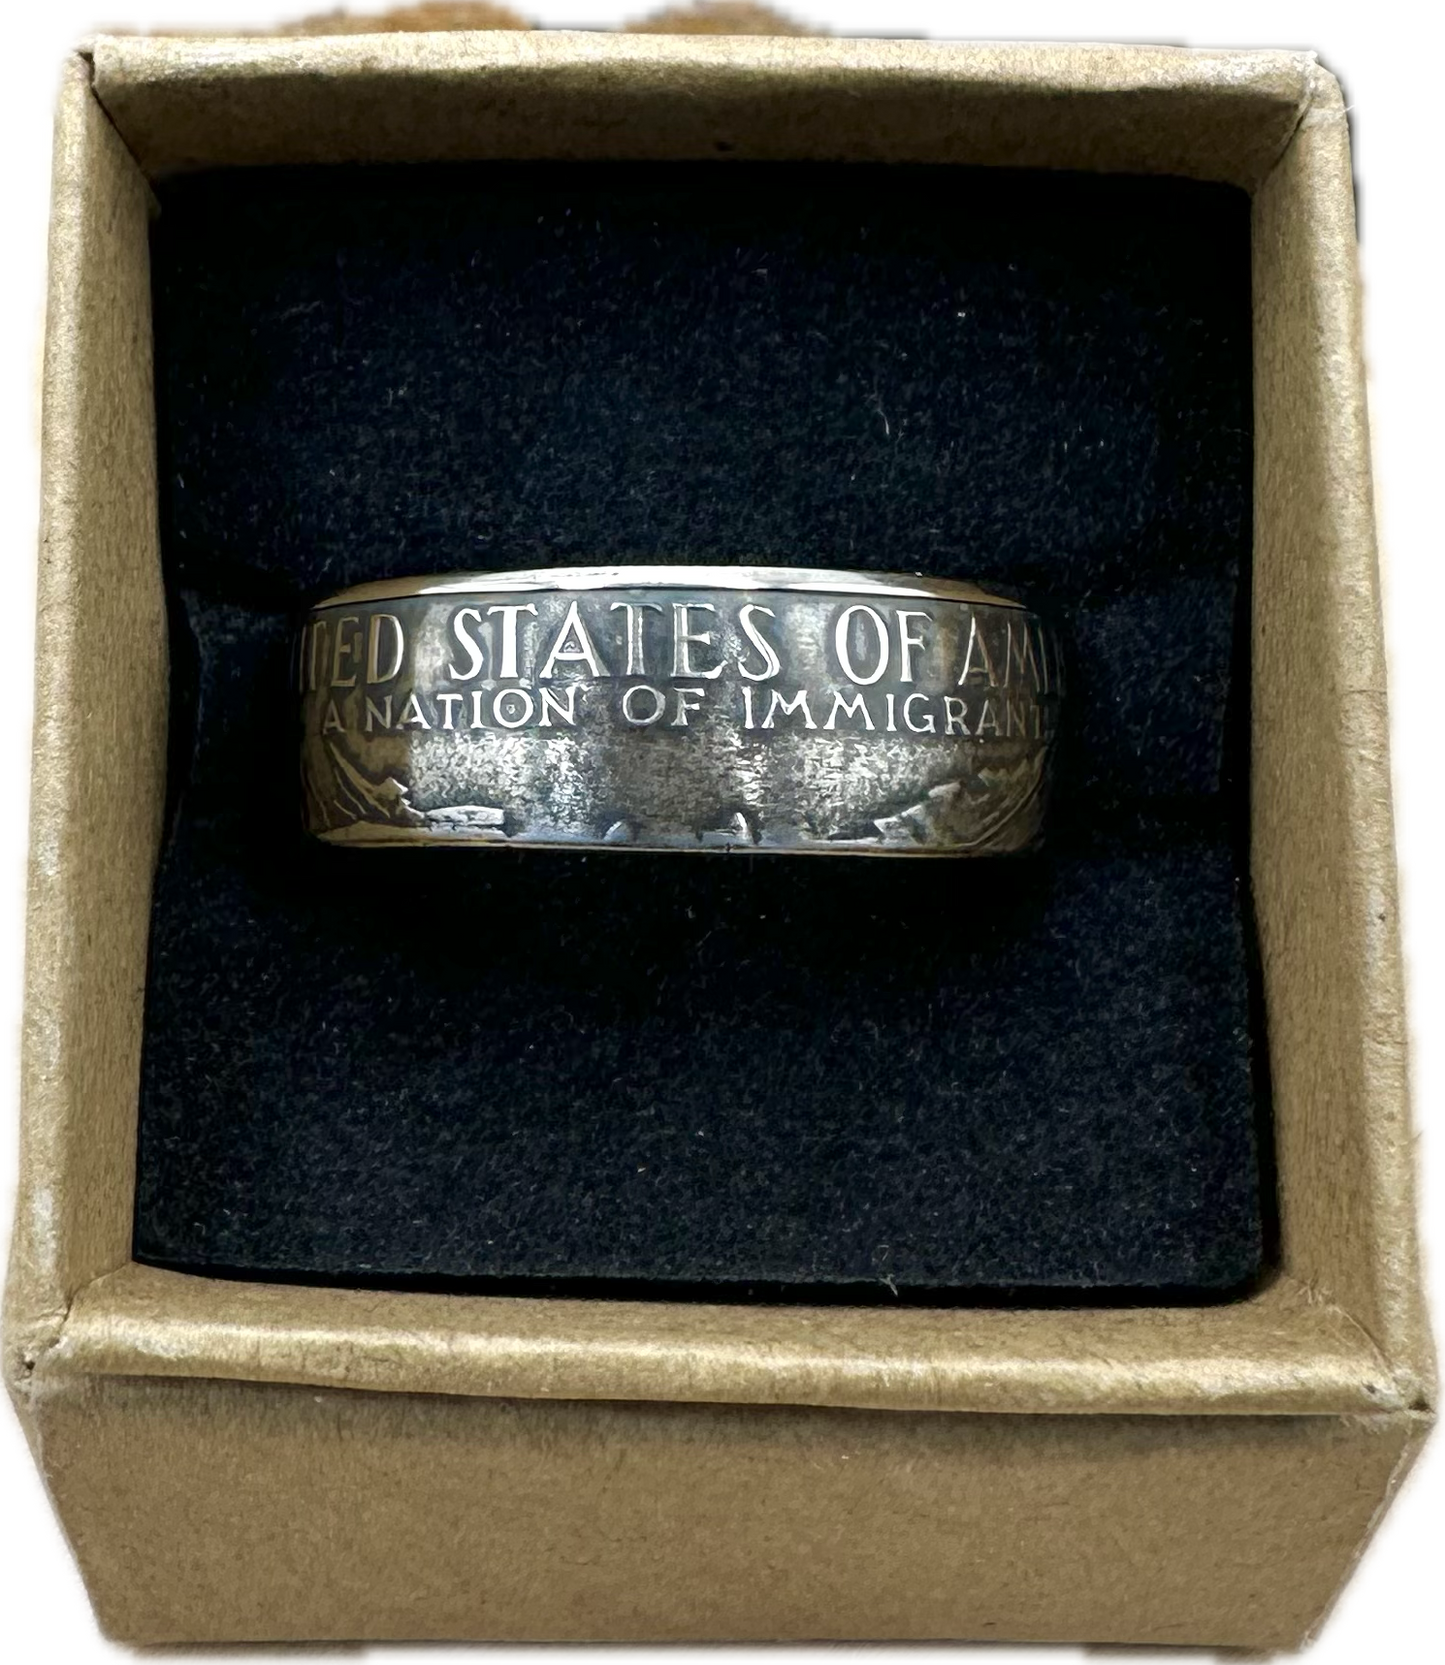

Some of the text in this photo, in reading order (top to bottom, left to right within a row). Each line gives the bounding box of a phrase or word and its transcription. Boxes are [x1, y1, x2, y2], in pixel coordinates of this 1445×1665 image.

[449, 601, 781, 681] STATES
[835, 604, 933, 686] OF
[322, 699, 346, 735] A
[366, 684, 577, 730] NATION
[622, 684, 706, 726] OF
